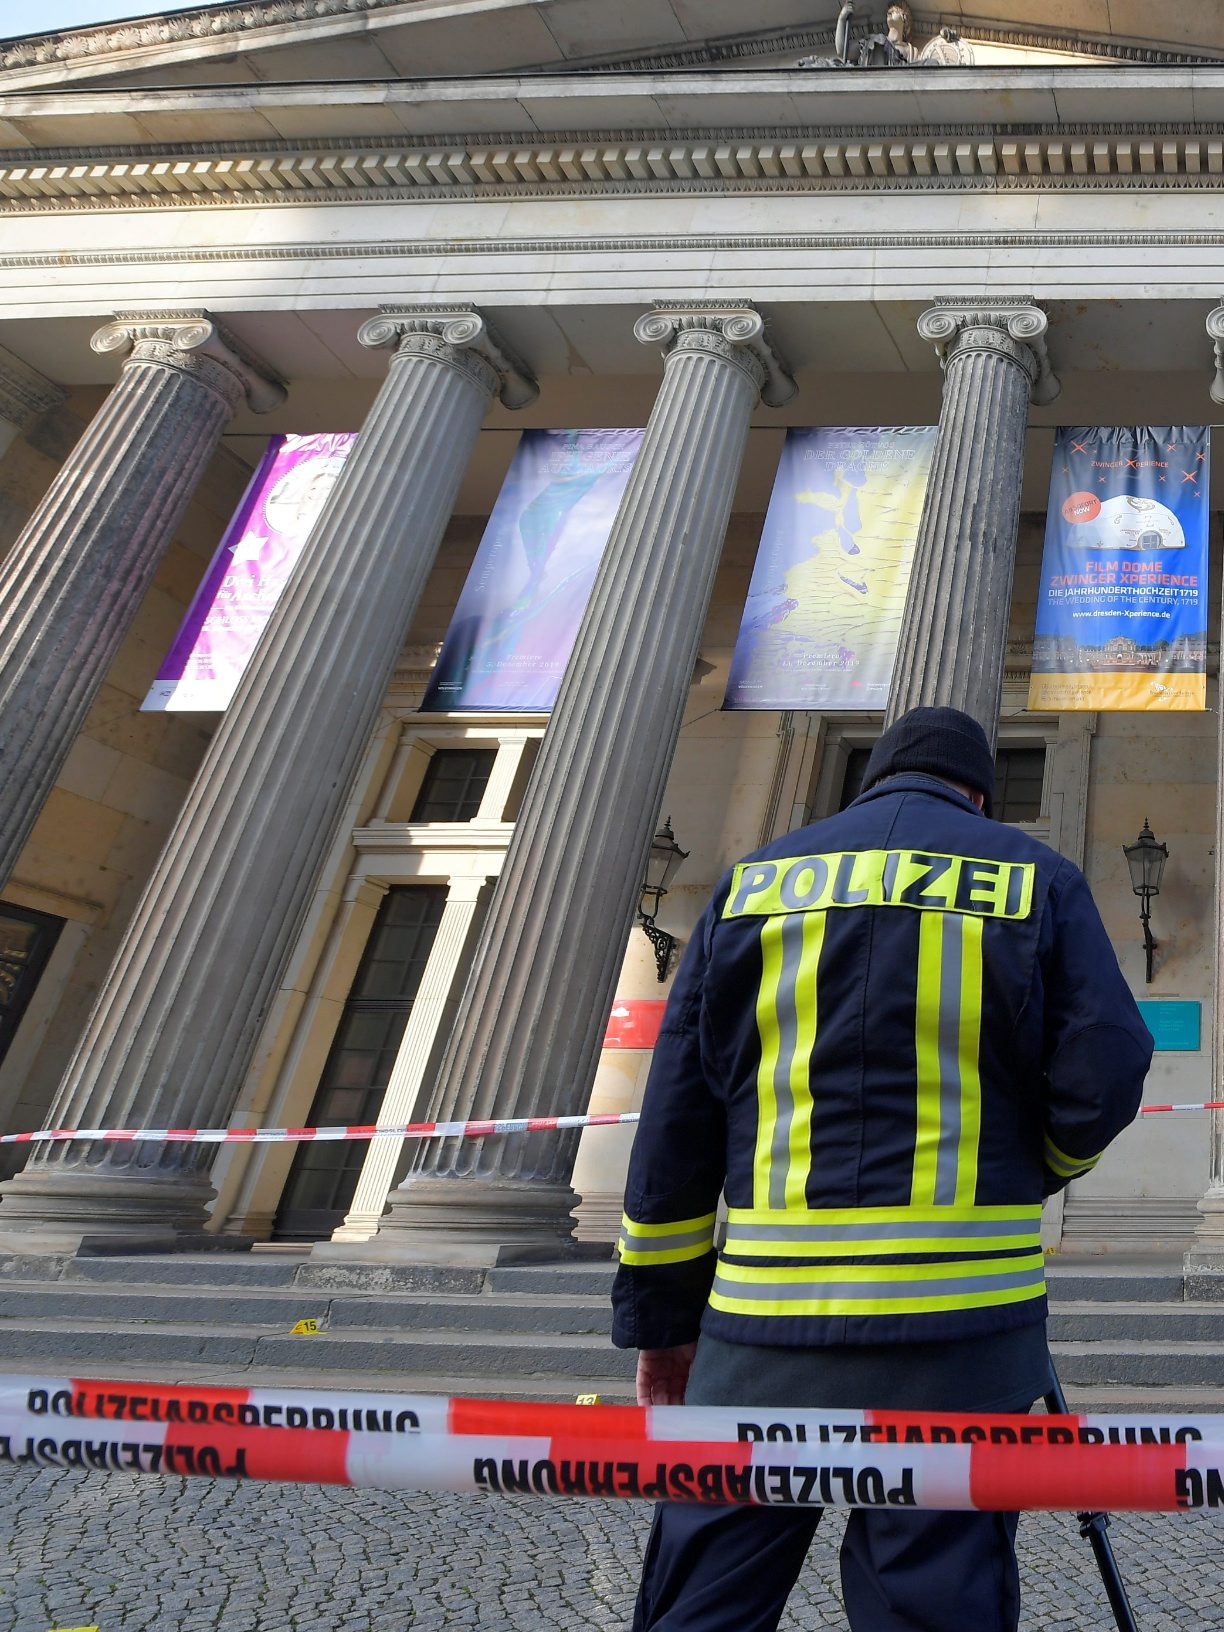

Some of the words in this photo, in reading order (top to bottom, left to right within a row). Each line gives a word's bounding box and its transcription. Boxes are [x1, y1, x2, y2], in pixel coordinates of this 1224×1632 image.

[1091, 460, 1123, 468] ZWINGER
[1085, 561, 1119, 572] FILM
[1122, 561, 1163, 572] DOME
[1050, 573, 1116, 587] ZWINGER
[1120, 573, 1198, 587] XPERIENCE
[1048, 588, 1063, 597] DIE
[1064, 586, 1179, 597] JAHRHUNDERTHOCHZEIT
[1179, 588, 1199, 597] 1719
[1048, 597, 1070, 606] THE
[1071, 596, 1106, 605] WEDDING
[1107, 595, 1120, 603] OF
[1121, 595, 1138, 604] THE
[1138, 596, 1180, 606] CENTURY,
[1181, 598, 1199, 606] 1719
[1072, 609, 1171, 619] www.dresden-Xperience.de
[730, 853, 1025, 915] POLIZEI
[304, 1321, 316, 1331] 15
[474, 1457, 918, 1506] POLIZEIABSPERRUNG
